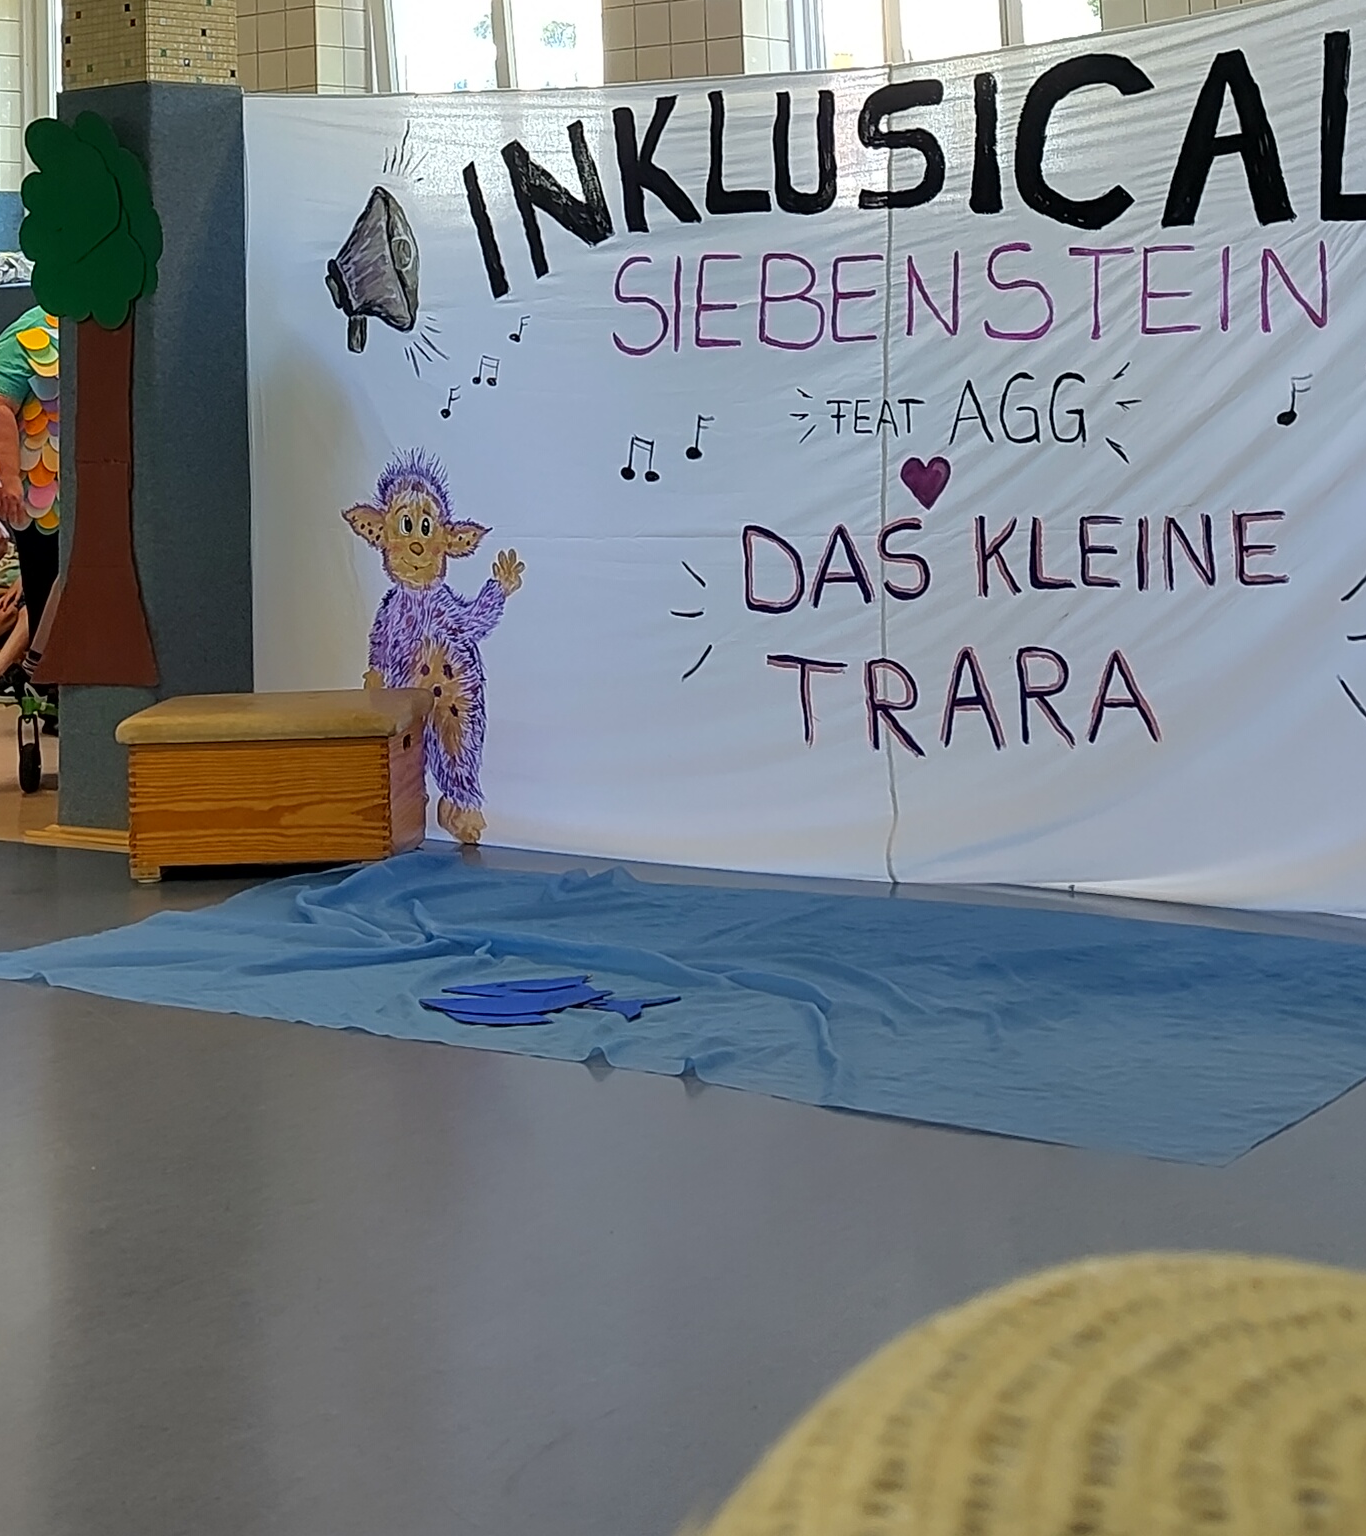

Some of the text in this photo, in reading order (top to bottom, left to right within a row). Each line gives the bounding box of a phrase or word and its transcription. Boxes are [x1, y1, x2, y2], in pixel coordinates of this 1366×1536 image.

[611, 240, 1331, 357] SIEBENSTEIN
[825, 370, 1090, 446] FEAT AGG
[739, 508, 1291, 616] DAS KLEINE
[765, 644, 1164, 759] TRARA
